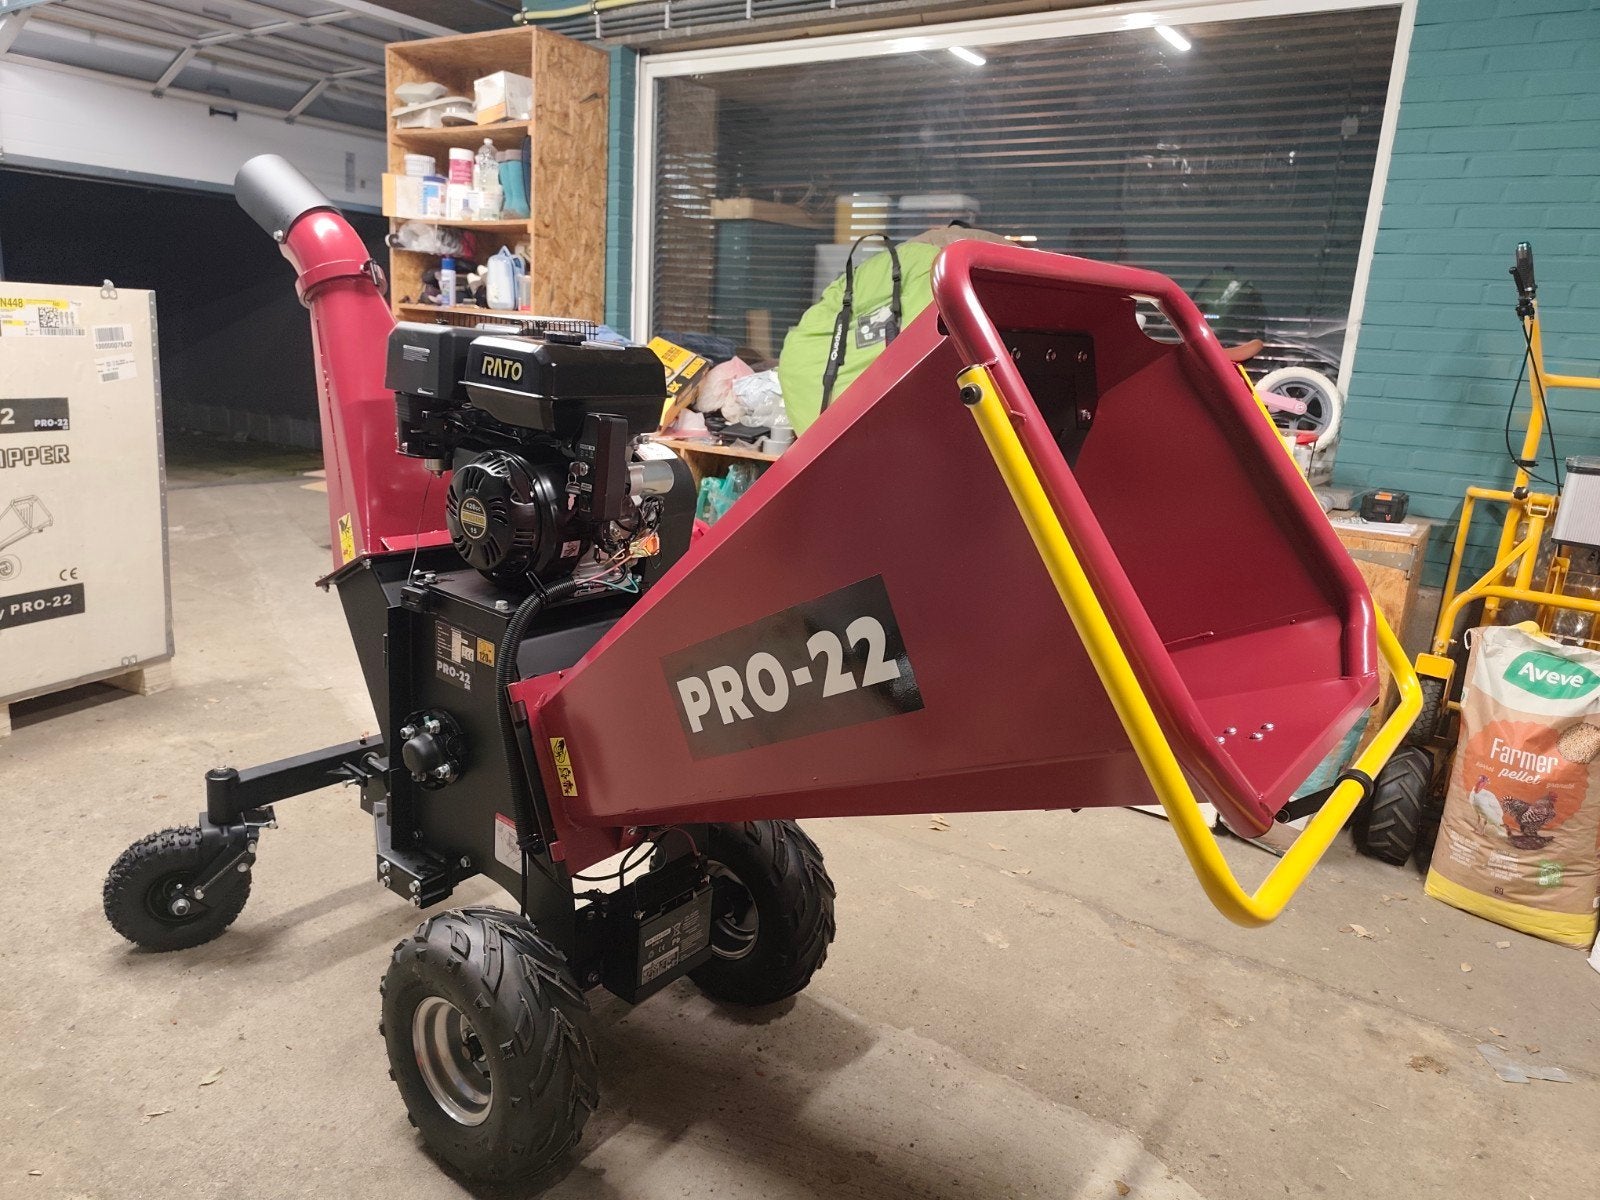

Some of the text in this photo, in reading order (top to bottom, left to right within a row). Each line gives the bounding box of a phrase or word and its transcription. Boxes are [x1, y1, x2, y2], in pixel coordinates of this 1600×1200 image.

[481, 356, 523, 381] RATO
[34, 418, 69, 427] PRO-22
[10, 594, 72, 616] PRO-22
[436, 660, 471, 685] PRO-22
[676, 616, 901, 734] PRO-22
[1518, 662, 1584, 688] Aveve
[1490, 738, 1559, 774] Farmer
[1497, 767, 1543, 785] pellet
